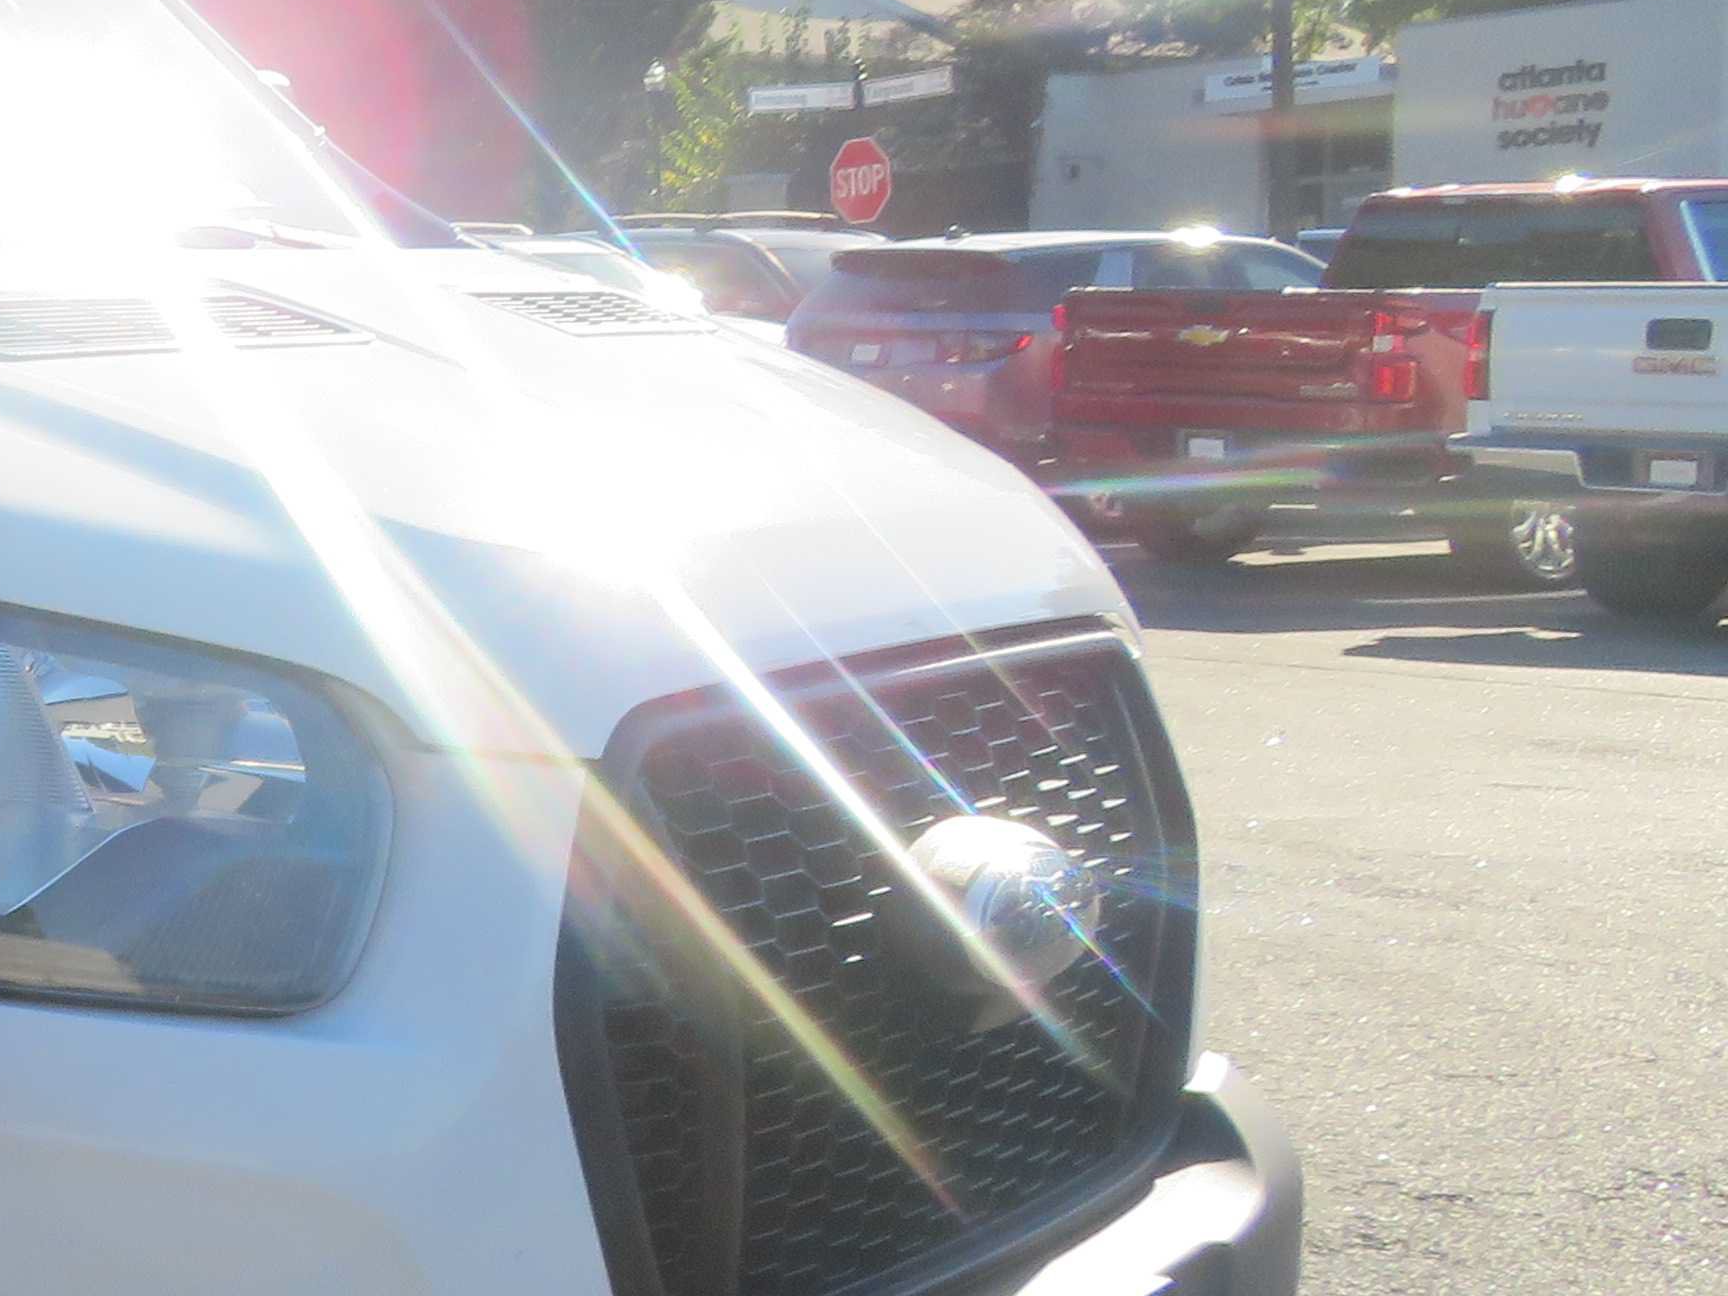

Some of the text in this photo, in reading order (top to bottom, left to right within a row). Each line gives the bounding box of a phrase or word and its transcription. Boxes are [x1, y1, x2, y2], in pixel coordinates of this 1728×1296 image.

[1497, 59, 1606, 92] atlanta
[1496, 118, 1602, 149] society
[835, 163, 884, 198] STOP
[1632, 356, 1718, 376] GMC
